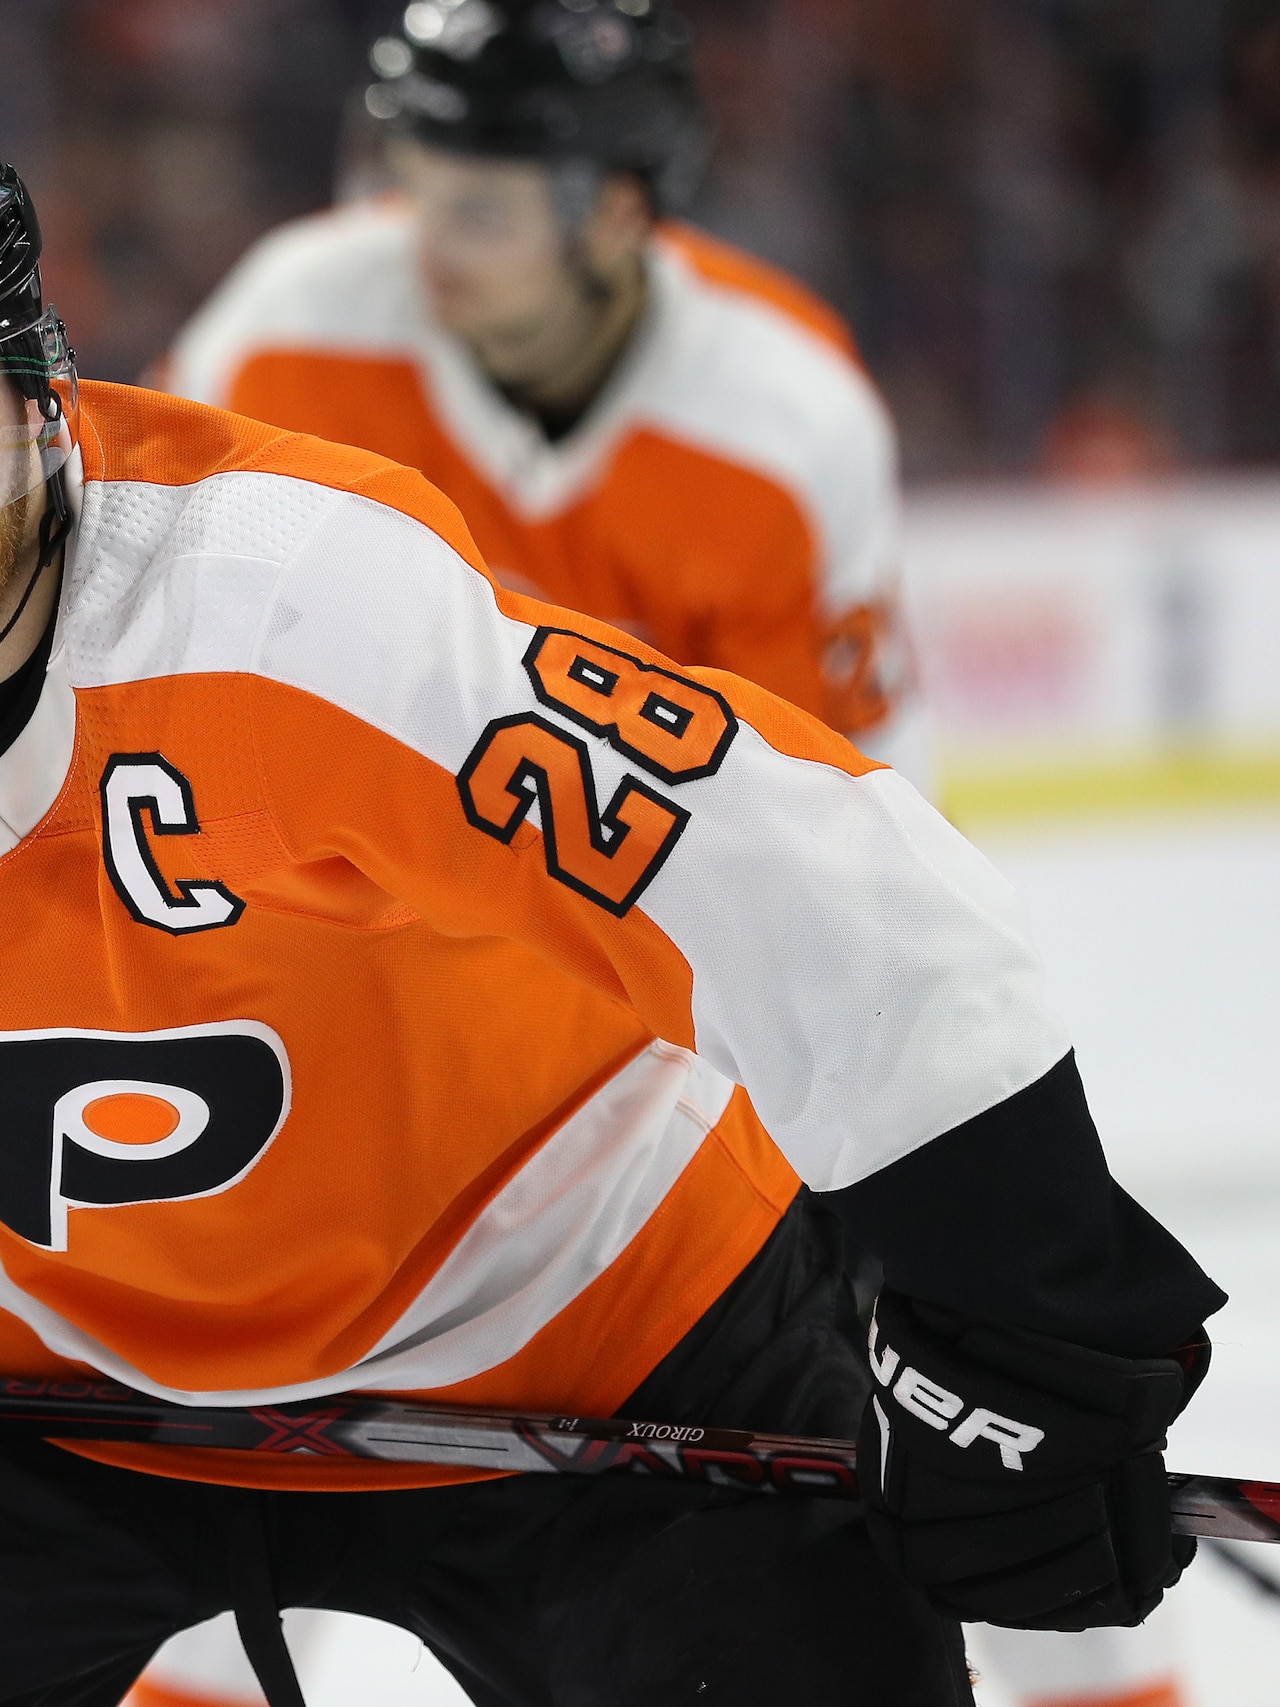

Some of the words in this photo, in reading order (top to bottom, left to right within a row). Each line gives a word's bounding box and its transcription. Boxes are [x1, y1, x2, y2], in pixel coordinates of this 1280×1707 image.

[99, 751, 246, 936] C
[455, 626, 739, 919] 28
[626, 1420, 706, 1442] GIROUX
